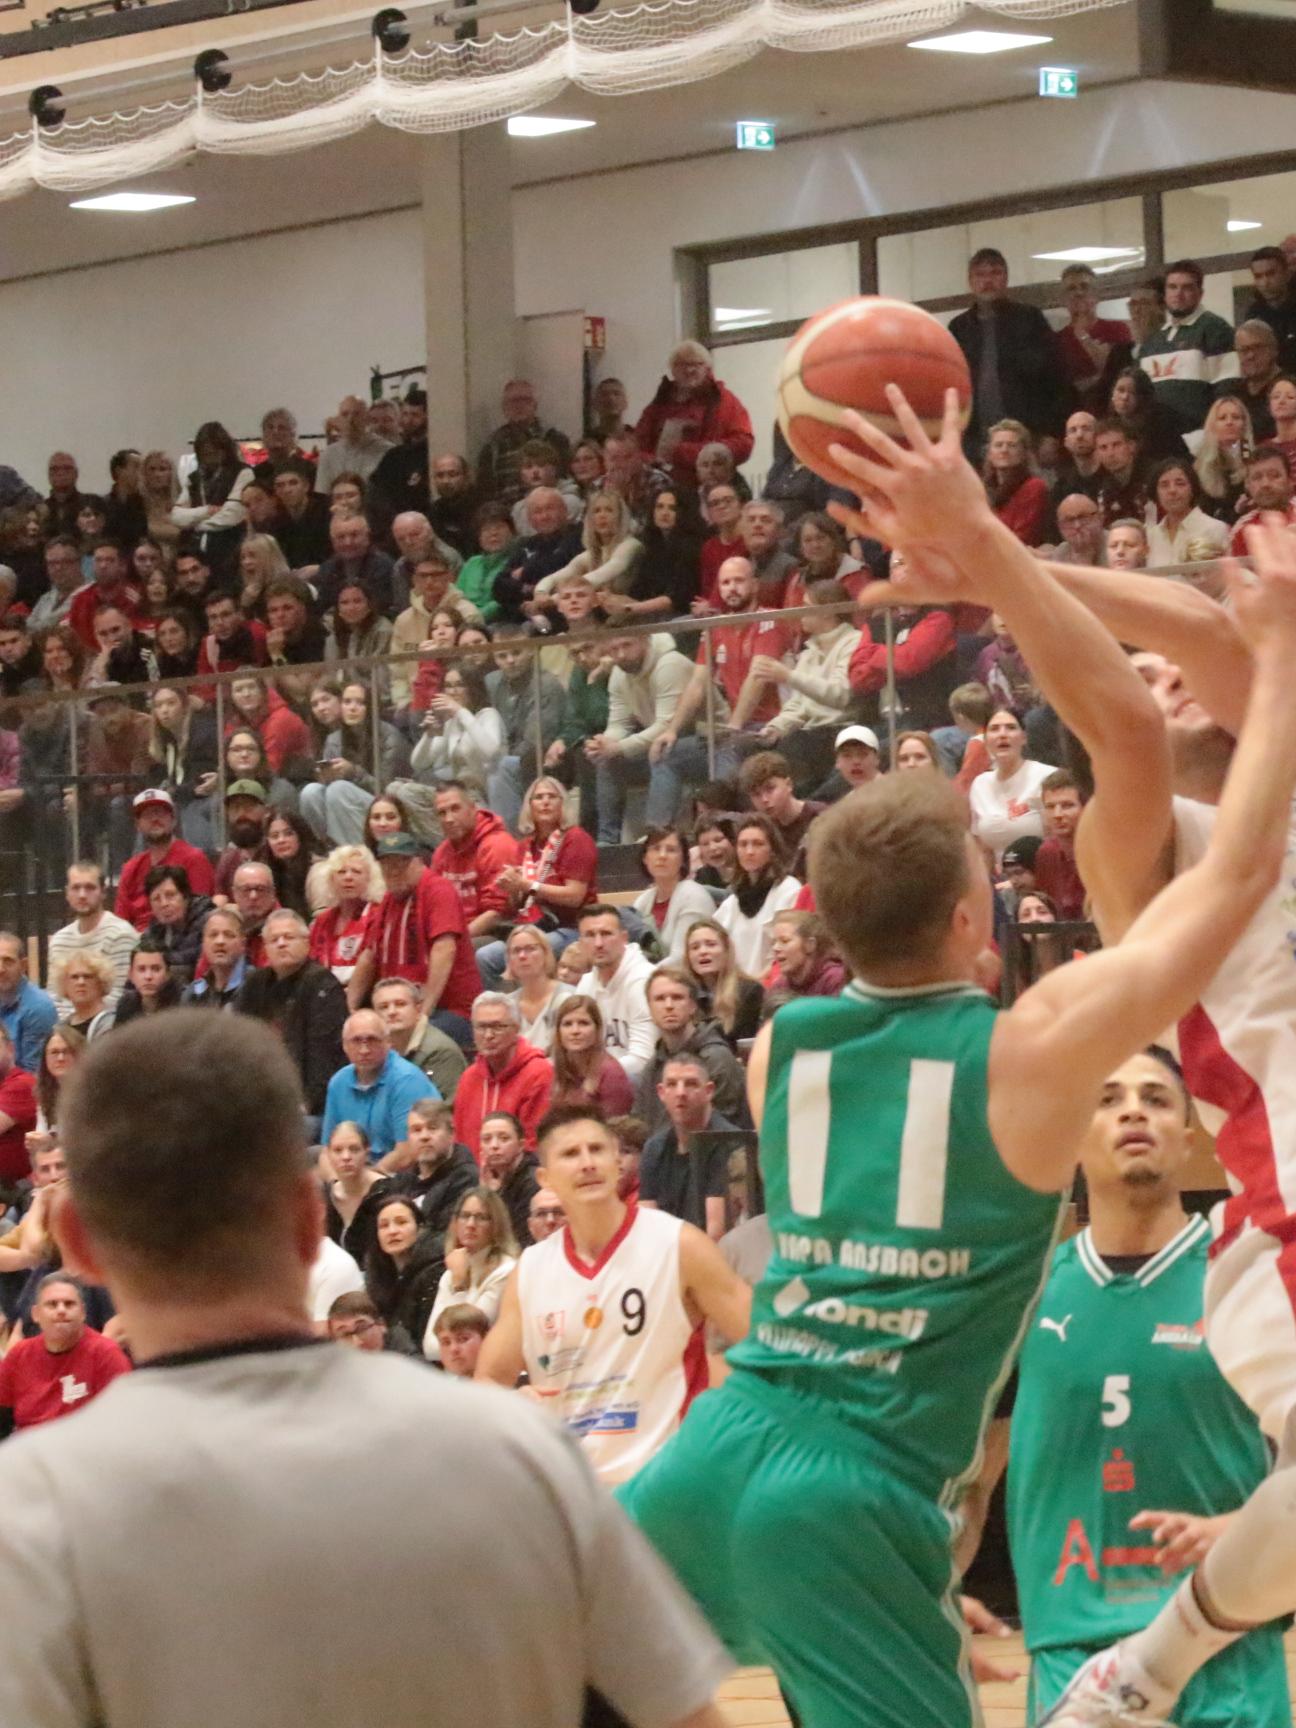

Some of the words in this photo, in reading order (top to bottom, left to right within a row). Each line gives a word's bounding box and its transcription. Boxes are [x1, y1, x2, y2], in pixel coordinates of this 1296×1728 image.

[787, 1049, 956, 1230] 11
[621, 1287, 646, 1336] 9
[1101, 1374, 1131, 1429] 5
